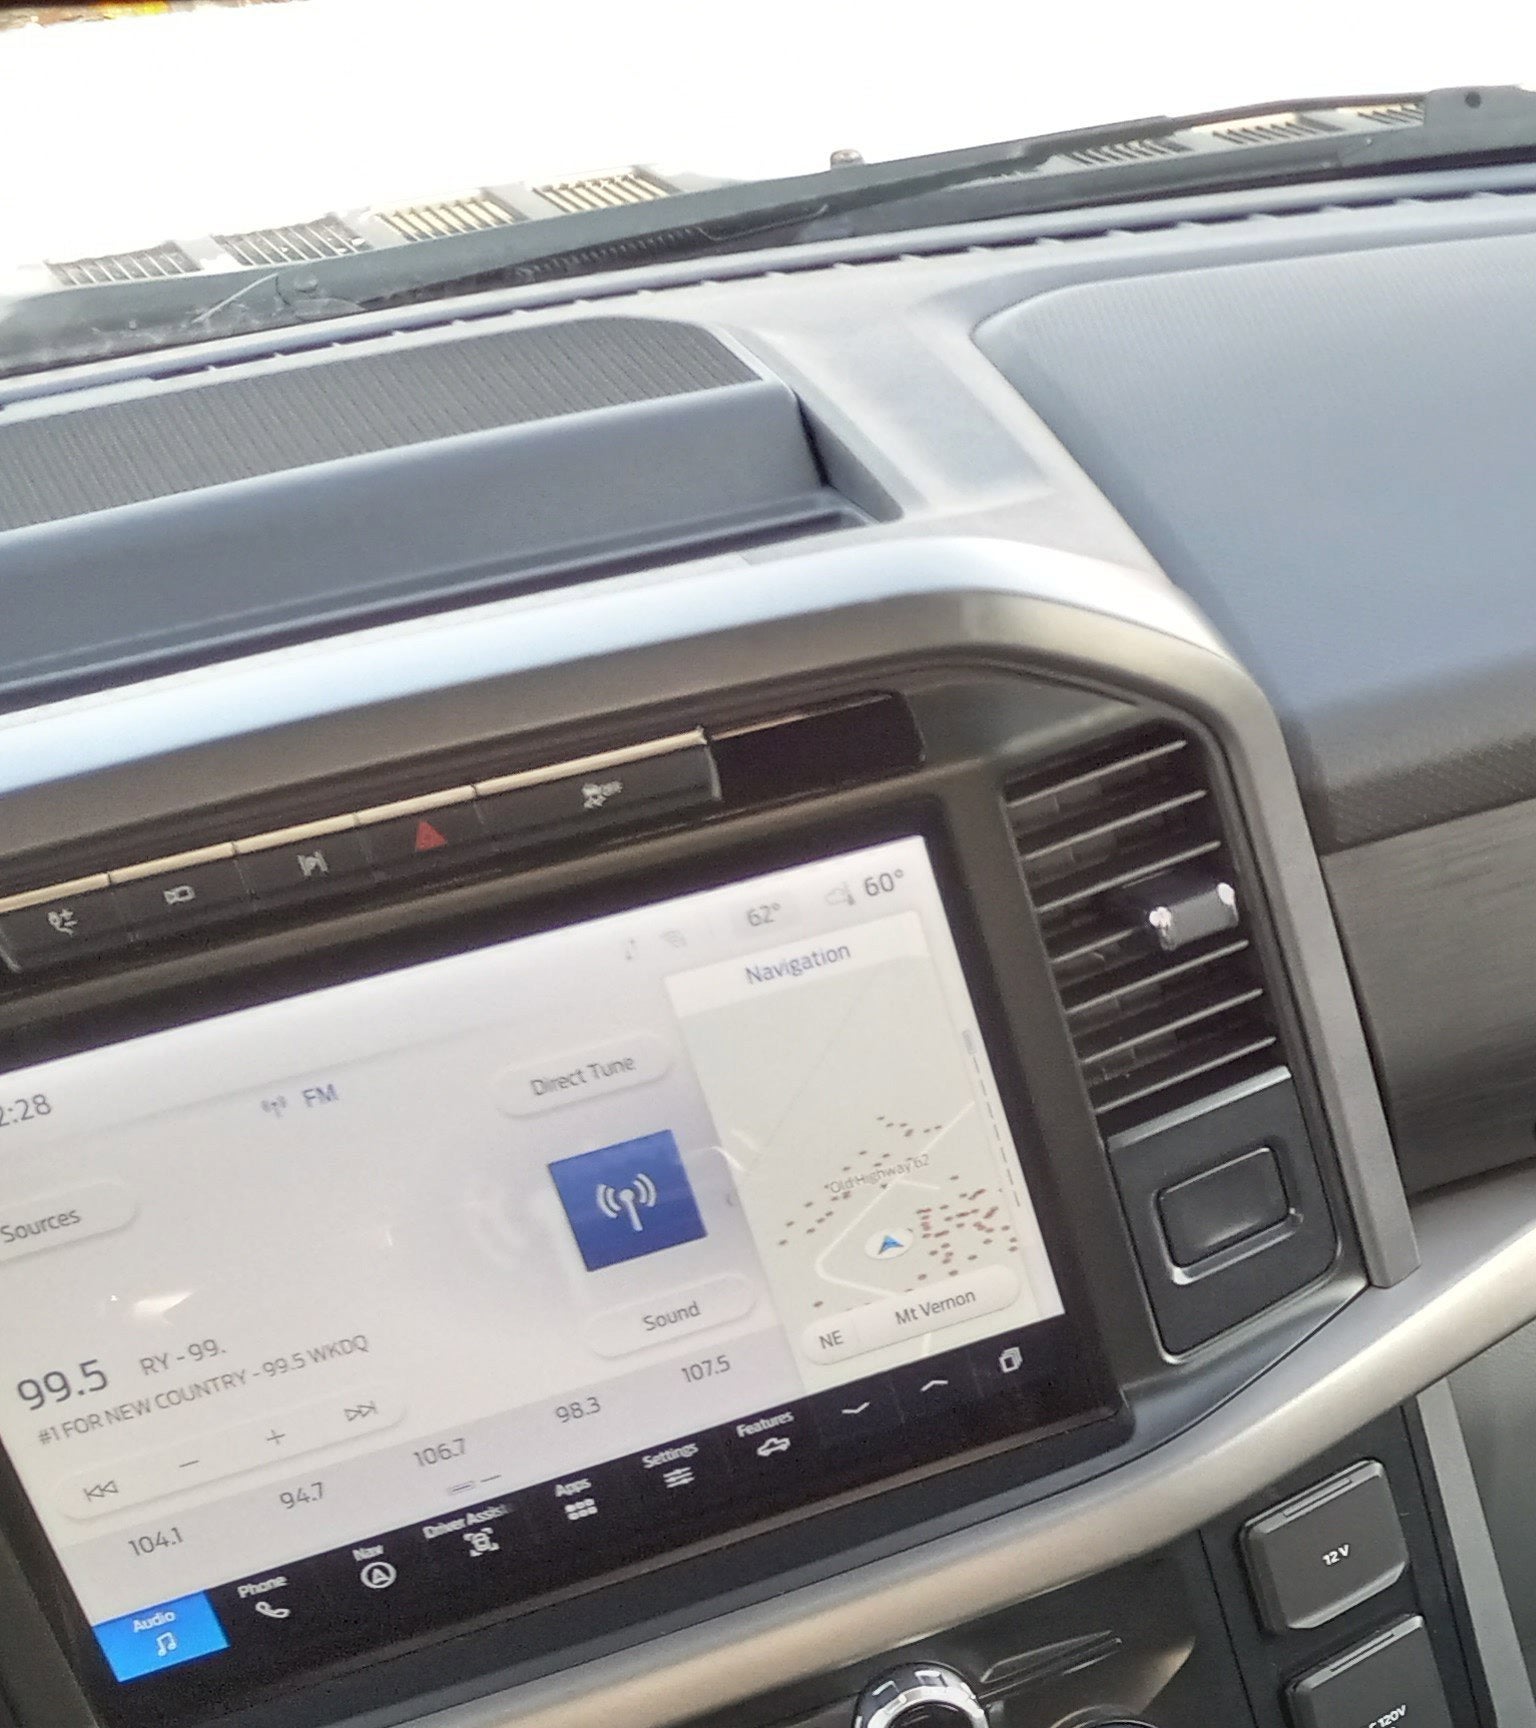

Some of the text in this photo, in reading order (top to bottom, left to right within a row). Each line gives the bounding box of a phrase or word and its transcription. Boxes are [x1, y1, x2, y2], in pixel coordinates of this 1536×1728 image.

[745, 943, 852, 985] Navigation
[530, 1056, 637, 1097] Direct Tune
[302, 1084, 339, 1108] FM
[830, 1177, 854, 1193] Old
[0, 1208, 82, 1244] Sources
[642, 1301, 702, 1331] Sound
[895, 1291, 976, 1325] Mt Vernon
[818, 1329, 845, 1350] NE
[139, 1352, 171, 1376] RY
[681, 1355, 732, 1384] 107.5
[17, 1358, 109, 1411] 99.5
[38, 1426, 60, 1445] #1
[62, 1412, 105, 1440] FOR
[105, 1399, 152, 1429] NEW
[155, 1368, 248, 1410] COUNTRY
[262, 1351, 306, 1378] 99.5
[306, 1334, 369, 1364] WKDQ
[556, 1396, 601, 1423] 98.3
[736, 1410, 794, 1439] Features
[412, 1437, 466, 1468] 106.7
[642, 1441, 699, 1469] Settings
[279, 1481, 325, 1510] 94.7
[554, 1477, 592, 1498] Apps
[128, 1526, 184, 1557] 104.1
[237, 1574, 288, 1599] Phone
[132, 1609, 176, 1634] Audio
[1378, 1704, 1407, 1728] 120V
